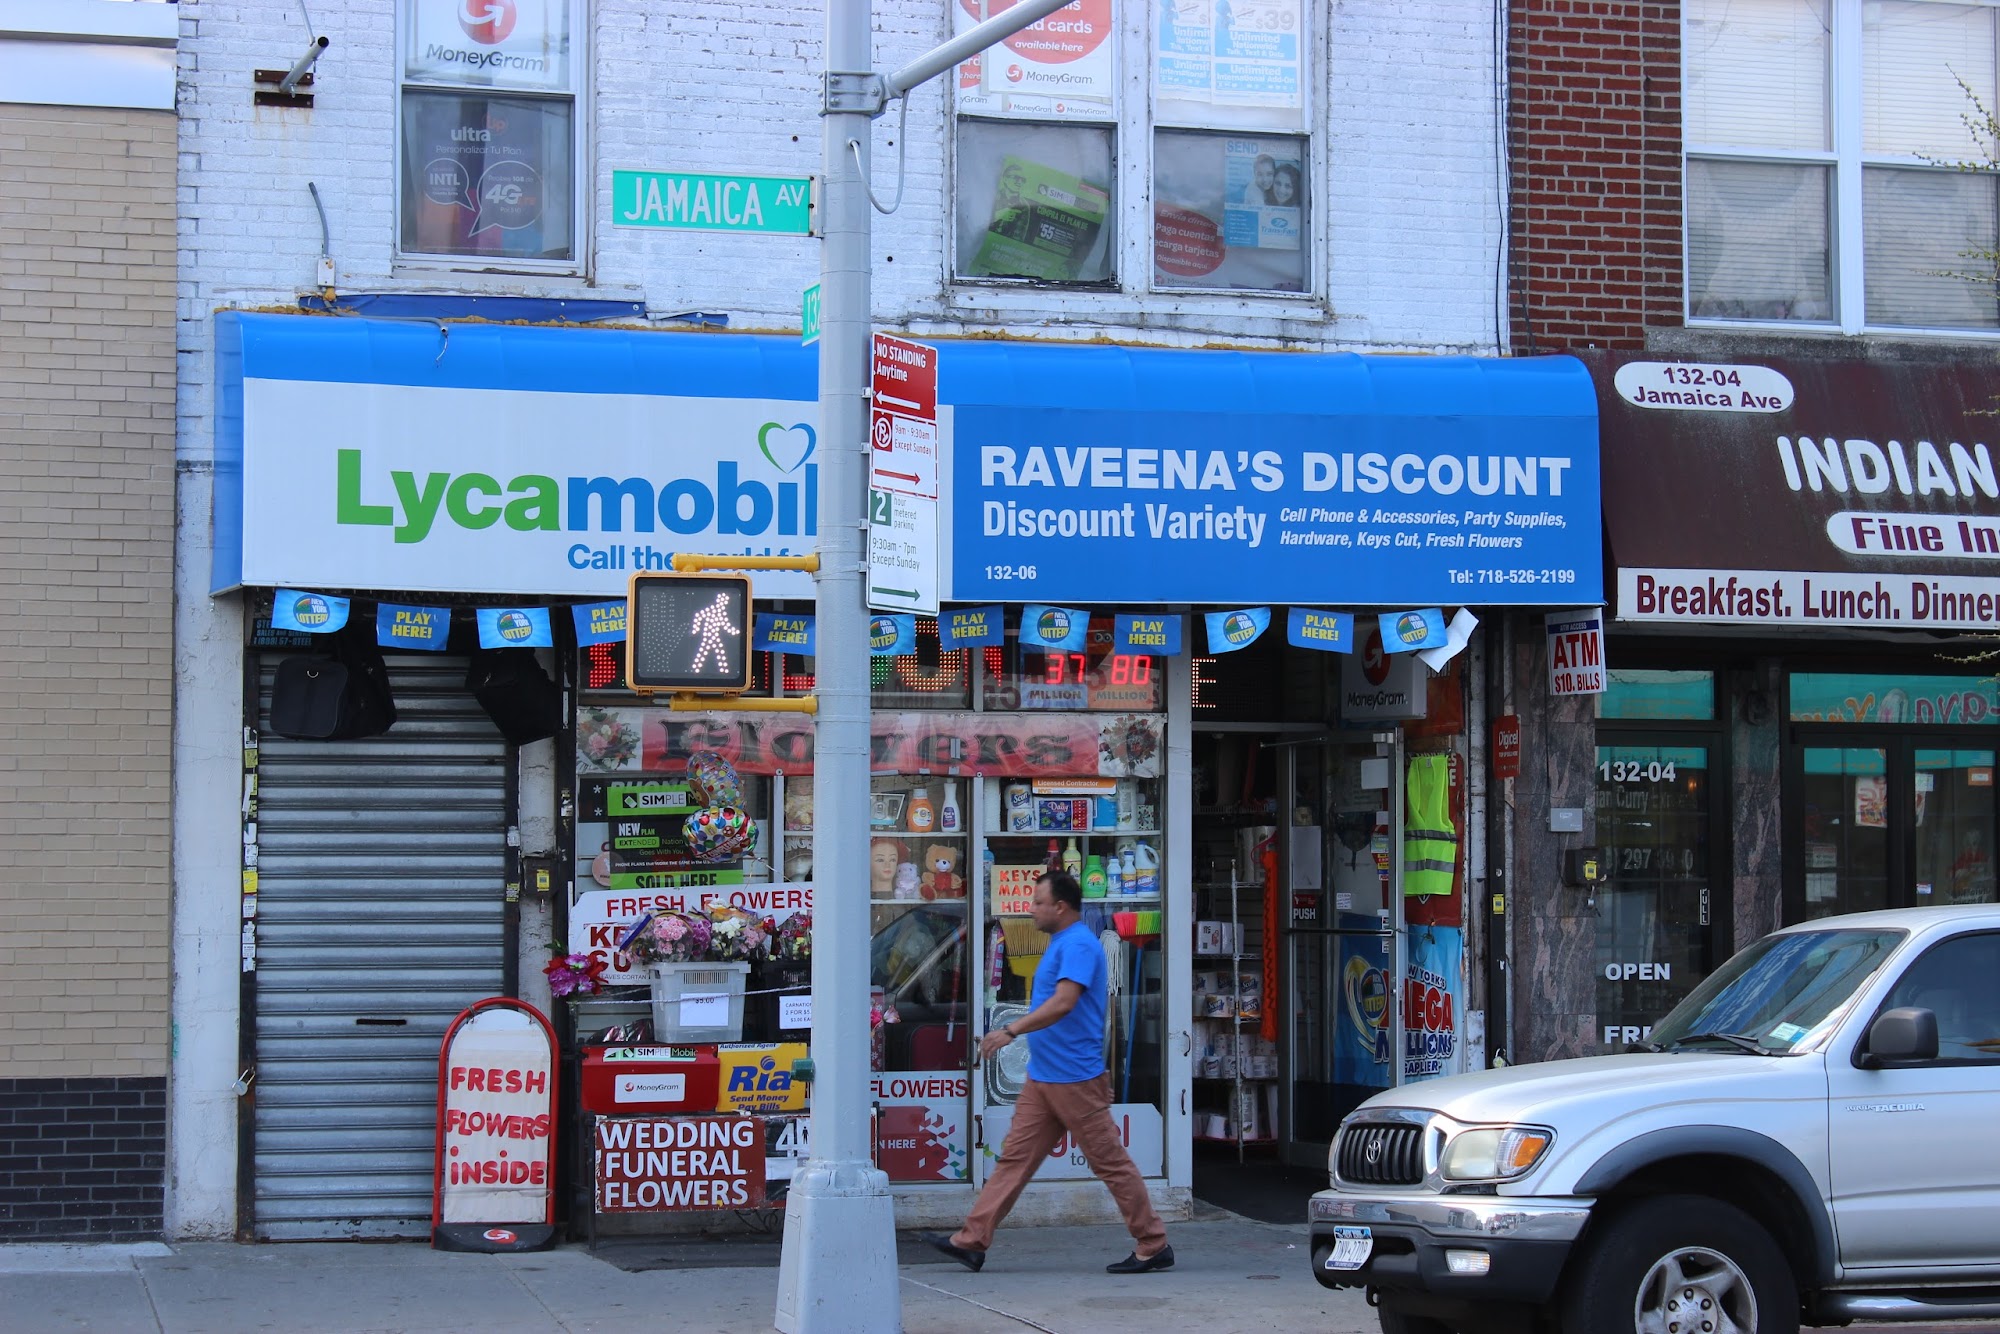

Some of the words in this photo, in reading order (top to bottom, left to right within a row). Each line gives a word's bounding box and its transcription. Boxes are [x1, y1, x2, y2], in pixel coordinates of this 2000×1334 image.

[1048, 20, 1092, 34] cards
[1256, 10, 1295, 30] $39
[1230, 31, 1280, 43] Unlimited
[1015, 41, 1060, 52] available
[1061, 42, 1084, 52] here
[1232, 41, 1278, 50] Nationwide
[426, 43, 545, 73] MoneyGram
[1230, 63, 1281, 76] Unlimited
[1026, 71, 1093, 85] MoneyGram
[1066, 107, 1107, 116] MoneyGram
[451, 126, 491, 142] ultra
[435, 145, 488, 154] Personalizar
[1226, 140, 1259, 154] SEND
[429, 173, 460, 186] INTL
[485, 184, 523, 205] 4G
[623, 177, 764, 226] JAMAICA
[775, 184, 805, 207] AV
[1155, 223, 1177, 235] Paga
[1178, 228, 1215, 242] cuentas
[1184, 244, 1219, 258] tarjetas
[1157, 254, 1192, 266] Disponible
[877, 342, 887, 358] NO
[889, 346, 926, 368] STANDING
[877, 361, 908, 382] Anytime
[1663, 367, 1741, 387] 132-04
[1633, 386, 1732, 408] Jamaica
[1740, 391, 1782, 410] Ave
[895, 439, 912, 452] Except
[913, 443, 932, 456] Sunday
[981, 445, 1284, 492] RAVEENA'S
[1302, 452, 1571, 496] DISCOUNT
[1776, 435, 1999, 499] INDIAN
[876, 492, 886, 522] 2
[893, 497, 906, 506] hour
[894, 509, 917, 519] metered
[983, 500, 1135, 537] Discount
[1145, 503, 1267, 548] Variety
[1280, 507, 1306, 523] Cell
[1310, 508, 1354, 523] Phone
[1358, 509, 1368, 523] &
[1372, 509, 1460, 527] Accessories,
[1463, 511, 1501, 528] Party
[1504, 512, 1567, 529] Supplies,
[894, 520, 914, 532] parking
[1280, 530, 1352, 548] Hardware,
[1356, 532, 1391, 549] Keys
[1394, 532, 1422, 549] Cut,
[1425, 533, 1464, 548] Fresh
[1468, 533, 1523, 548] Flowers
[1851, 518, 1944, 552] Fine
[1957, 521, 2000, 553] In
[872, 538, 896, 552] 9:30am
[904, 542, 917, 555] 7pm
[568, 544, 625, 570] Call
[632, 546, 673, 570] the
[872, 552, 895, 567] Except
[897, 556, 920, 572] Sunday
[985, 565, 1037, 580] 132-06
[1448, 569, 1473, 584] Tel:
[1478, 569, 1575, 584] 718-526-2199
[1636, 575, 1791, 617] Breakfast.
[1803, 579, 1900, 620] Lunch.
[312, 605, 327, 613] YORK
[591, 606, 625, 621] PLAY
[1054, 611, 1066, 619] NEW
[396, 611, 431, 624] PLAY
[511, 613, 525, 621] NEW
[512, 619, 529, 627] YORK
[953, 613, 985, 626] PLAY
[1055, 619, 1069, 627] YORK
[1306, 615, 1337, 628] PLAY
[590, 618, 627, 634] HERE
[773, 619, 807, 631] PLAY
[881, 625, 896, 635] YORK
[1132, 621, 1164, 632] PLAY
[1239, 621, 1253, 630] YORK
[1410, 620, 1425, 629] YORK
[1570, 622, 1587, 630] ACCESS
[392, 625, 432, 639] HERE!
[768, 630, 808, 644] HERE!
[952, 625, 988, 639] HERE!
[1040, 627, 1069, 638] LOTTERY
[1129, 633, 1166, 645] HERE!
[1302, 626, 1339, 641] HERE!
[1553, 632, 1599, 670] ATM
[1046, 654, 1086, 684] 37
[1111, 655, 1151, 685] 80
[1578, 673, 1600, 691] BILLS
[1029, 690, 1081, 700] MILLION
[1096, 691, 1148, 700] MILLION
[1348, 691, 1405, 709] MoneyGram
[1499, 729, 1519, 750] Digicel
[1600, 761, 1676, 782] 132-04
[642, 794, 685, 805] SIMPLE
[1617, 785, 1649, 814] Curry
[618, 823, 641, 837] NEW
[620, 839, 657, 847] EXTENDED
[1624, 848, 1652, 870] 297
[636, 874, 677, 889] SOLD
[680, 873, 717, 887] HERE
[1000, 869, 1041, 883] KEYS
[607, 895, 685, 918] FRESH
[701, 889, 812, 912] FOWERS
[1293, 908, 1316, 921] PUSH
[1605, 963, 1671, 980] OPEN
[1374, 1030, 1454, 1059] MLLIONS
[637, 1048, 670, 1056] SIMPLE
[450, 1066, 547, 1095] FRESH
[727, 1056, 792, 1092] Ria
[636, 1084, 679, 1092] MoneyGram
[729, 1094, 754, 1103] Send
[756, 1095, 789, 1103] Money
[738, 1103, 757, 1111] Pay
[759, 1103, 781, 1111] Bills
[1874, 1103, 1925, 1113] TACOMA
[446, 1109, 550, 1141] FLOWERS
[600, 1121, 754, 1150] WEDDING
[888, 1139, 916, 1149] HERE
[605, 1150, 746, 1178] FUNERAL
[605, 1179, 748, 1208] FLOWERS
